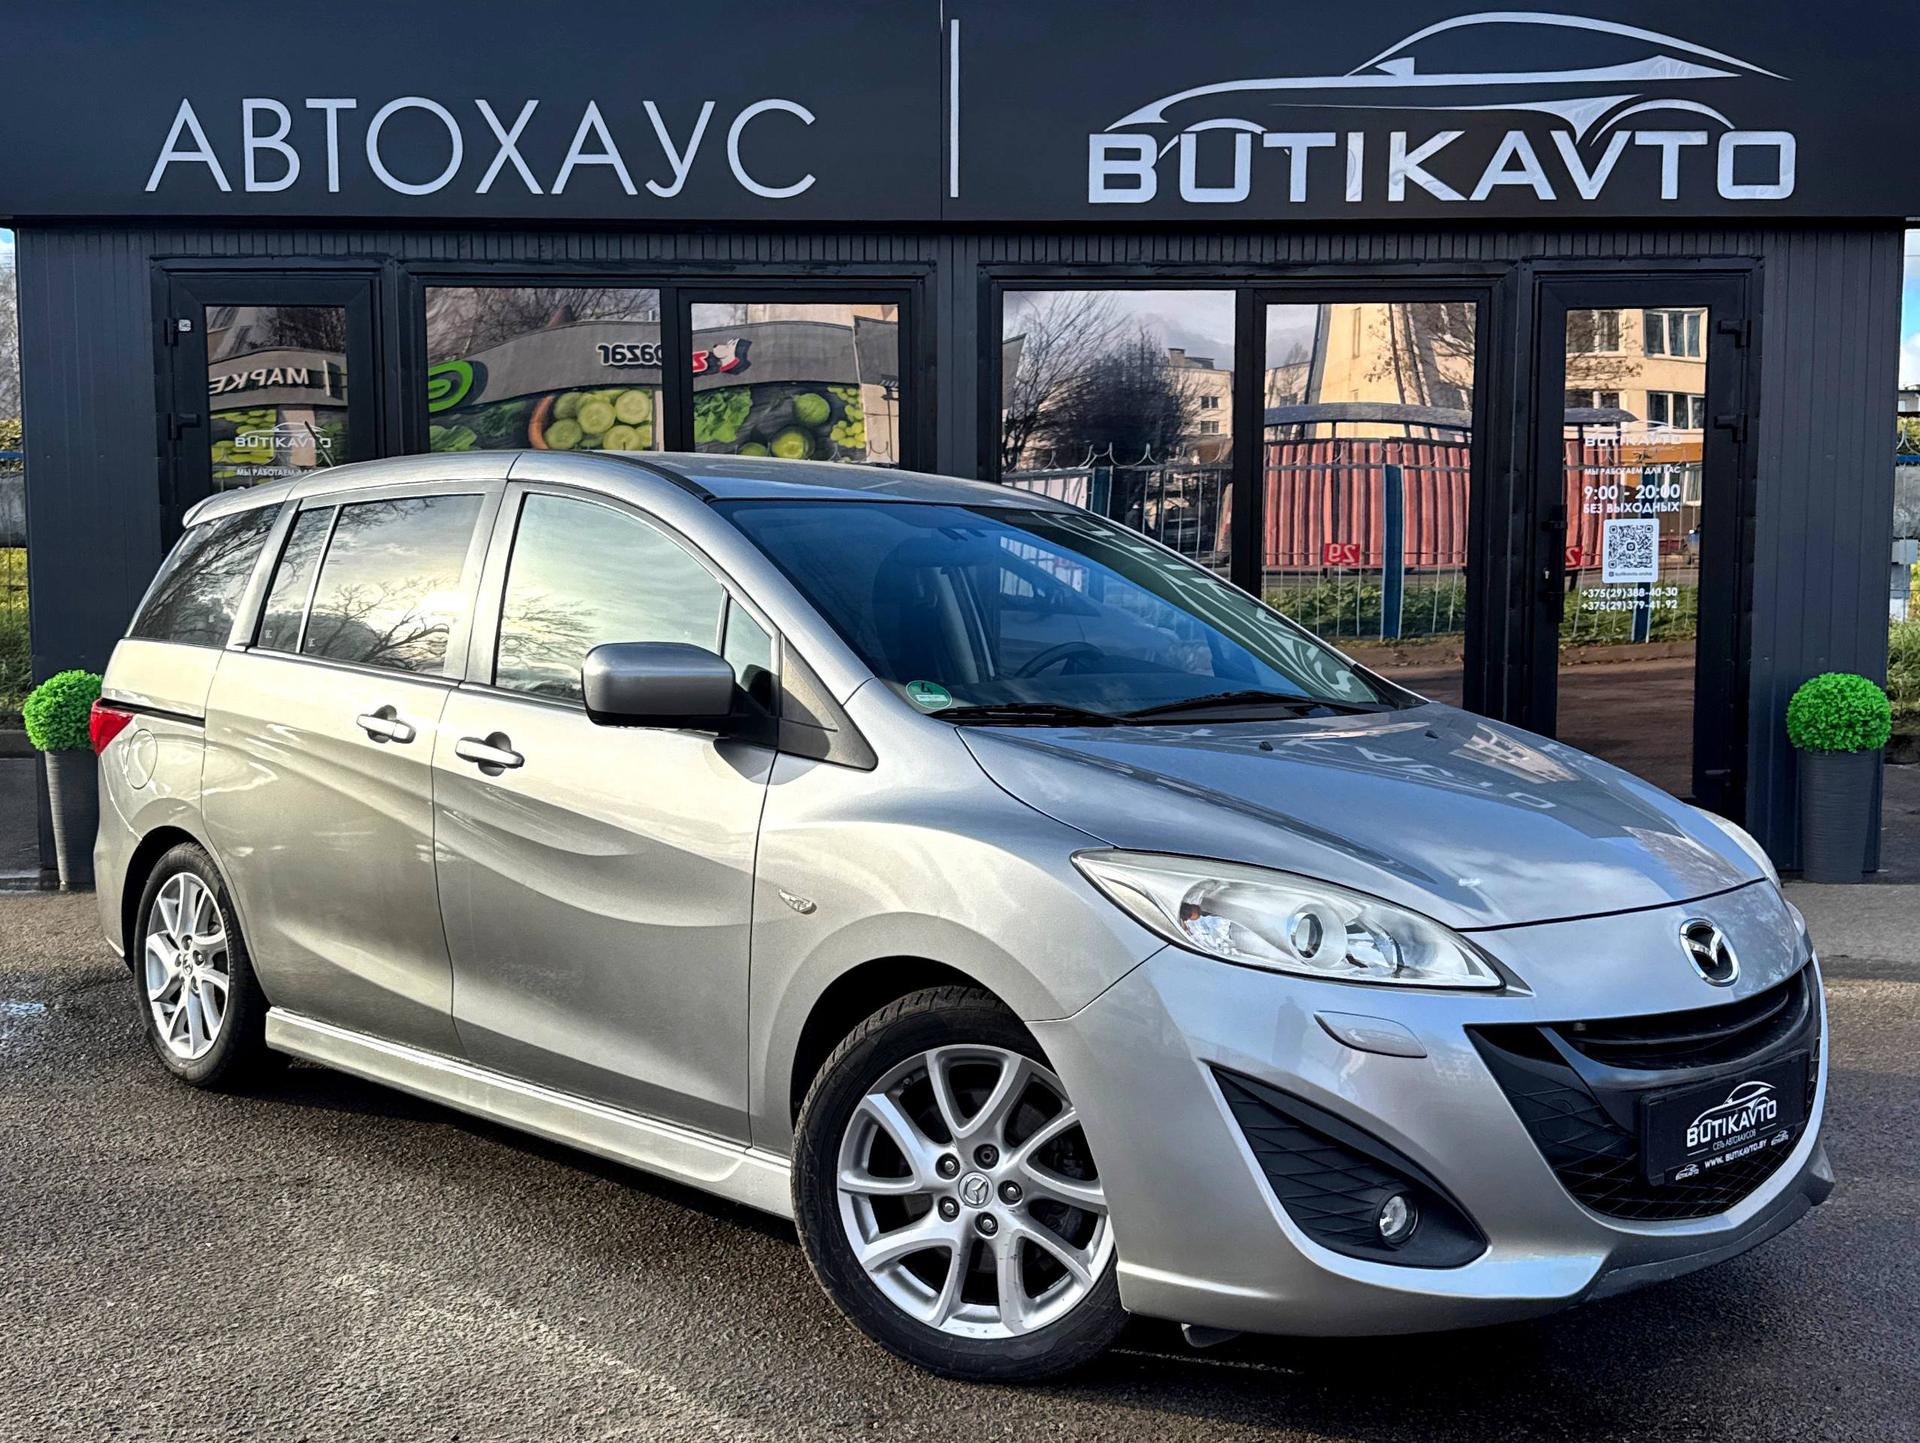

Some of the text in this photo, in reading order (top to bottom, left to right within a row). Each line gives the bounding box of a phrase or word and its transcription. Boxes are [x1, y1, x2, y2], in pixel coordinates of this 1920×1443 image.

[145, 96, 817, 199] АВТОХАУС
[1088, 130, 1797, 204] BUTIKAVTO
[1583, 486, 1618, 500] 9:00
[1635, 484, 1680, 499] 20:00
[1583, 502, 1680, 514] БЕЗ ВЫХОДНЫХ
[1582, 587, 1678, 599] +375(29)388-40-30
[1687, 1100, 1777, 1147] BUTIKAVTO
